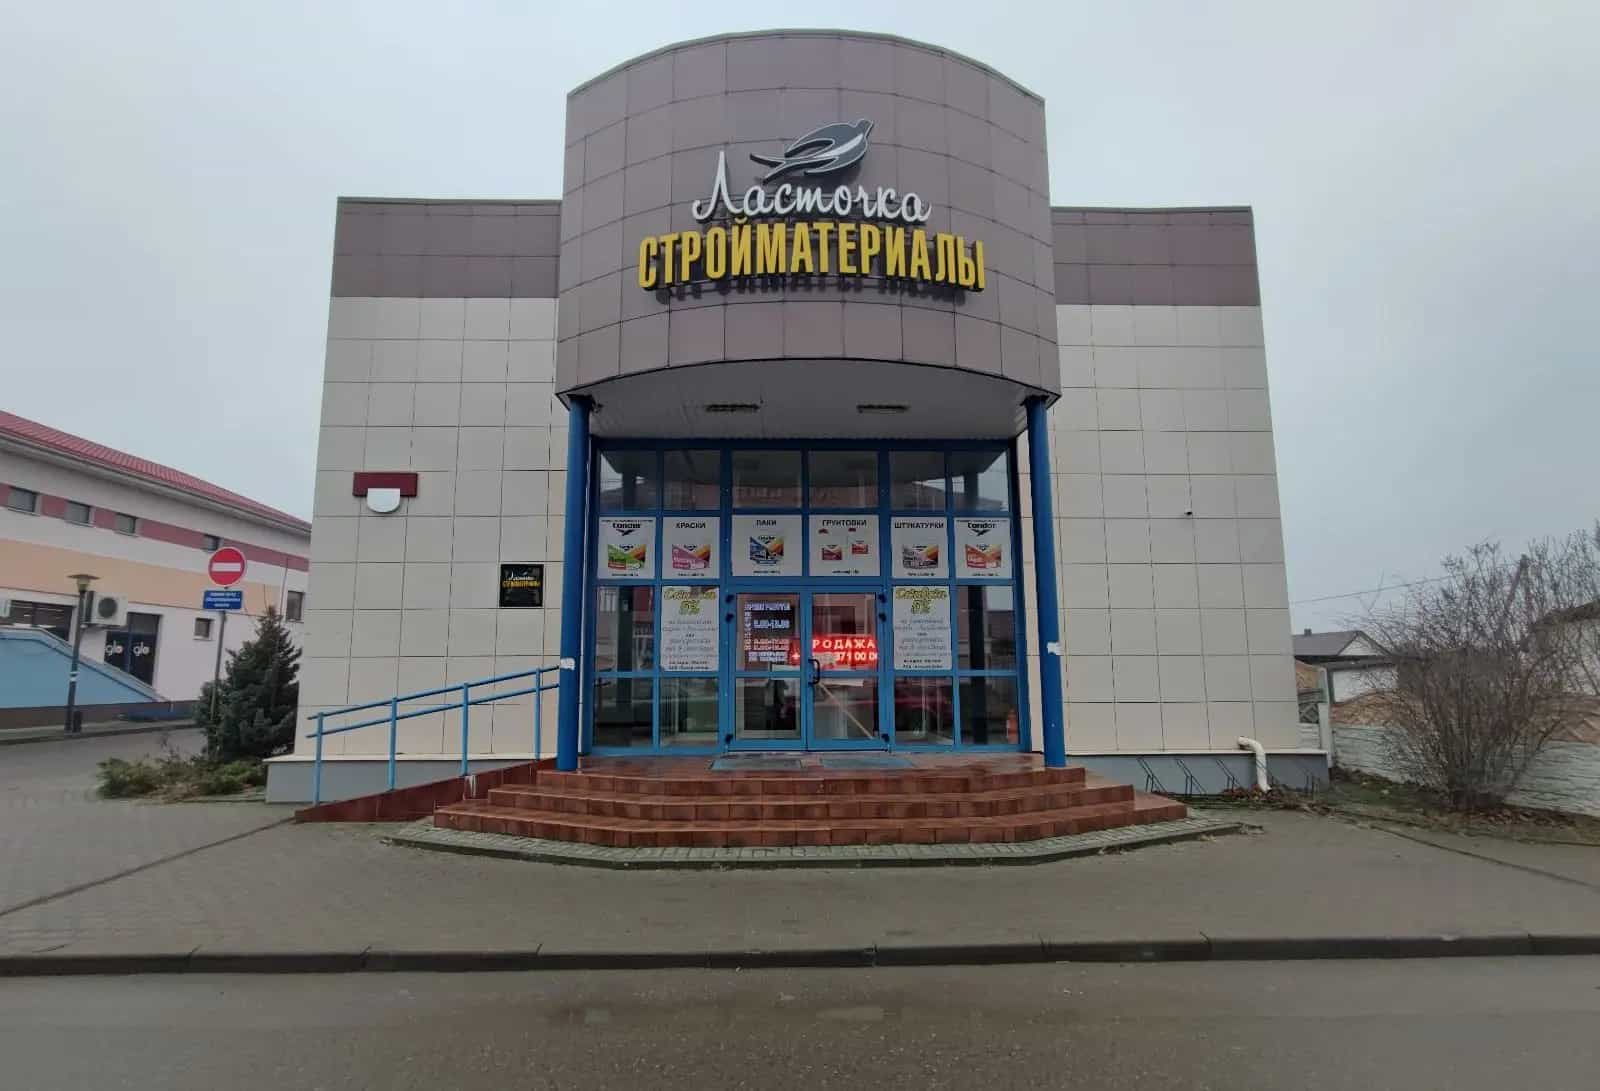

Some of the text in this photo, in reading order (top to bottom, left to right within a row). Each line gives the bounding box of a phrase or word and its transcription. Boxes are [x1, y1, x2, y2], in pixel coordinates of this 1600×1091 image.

[692, 151, 933, 222] Ласточка
[638, 215, 986, 291] СТРОЙМАТЕРИАЛЫ
[675, 521, 706, 529] КРАСКИ
[821, 519, 867, 527] ГРУНТОВКИ
[894, 521, 944, 529] ШТУКАТУРКИ
[812, 639, 876, 650] РОДАЖА
